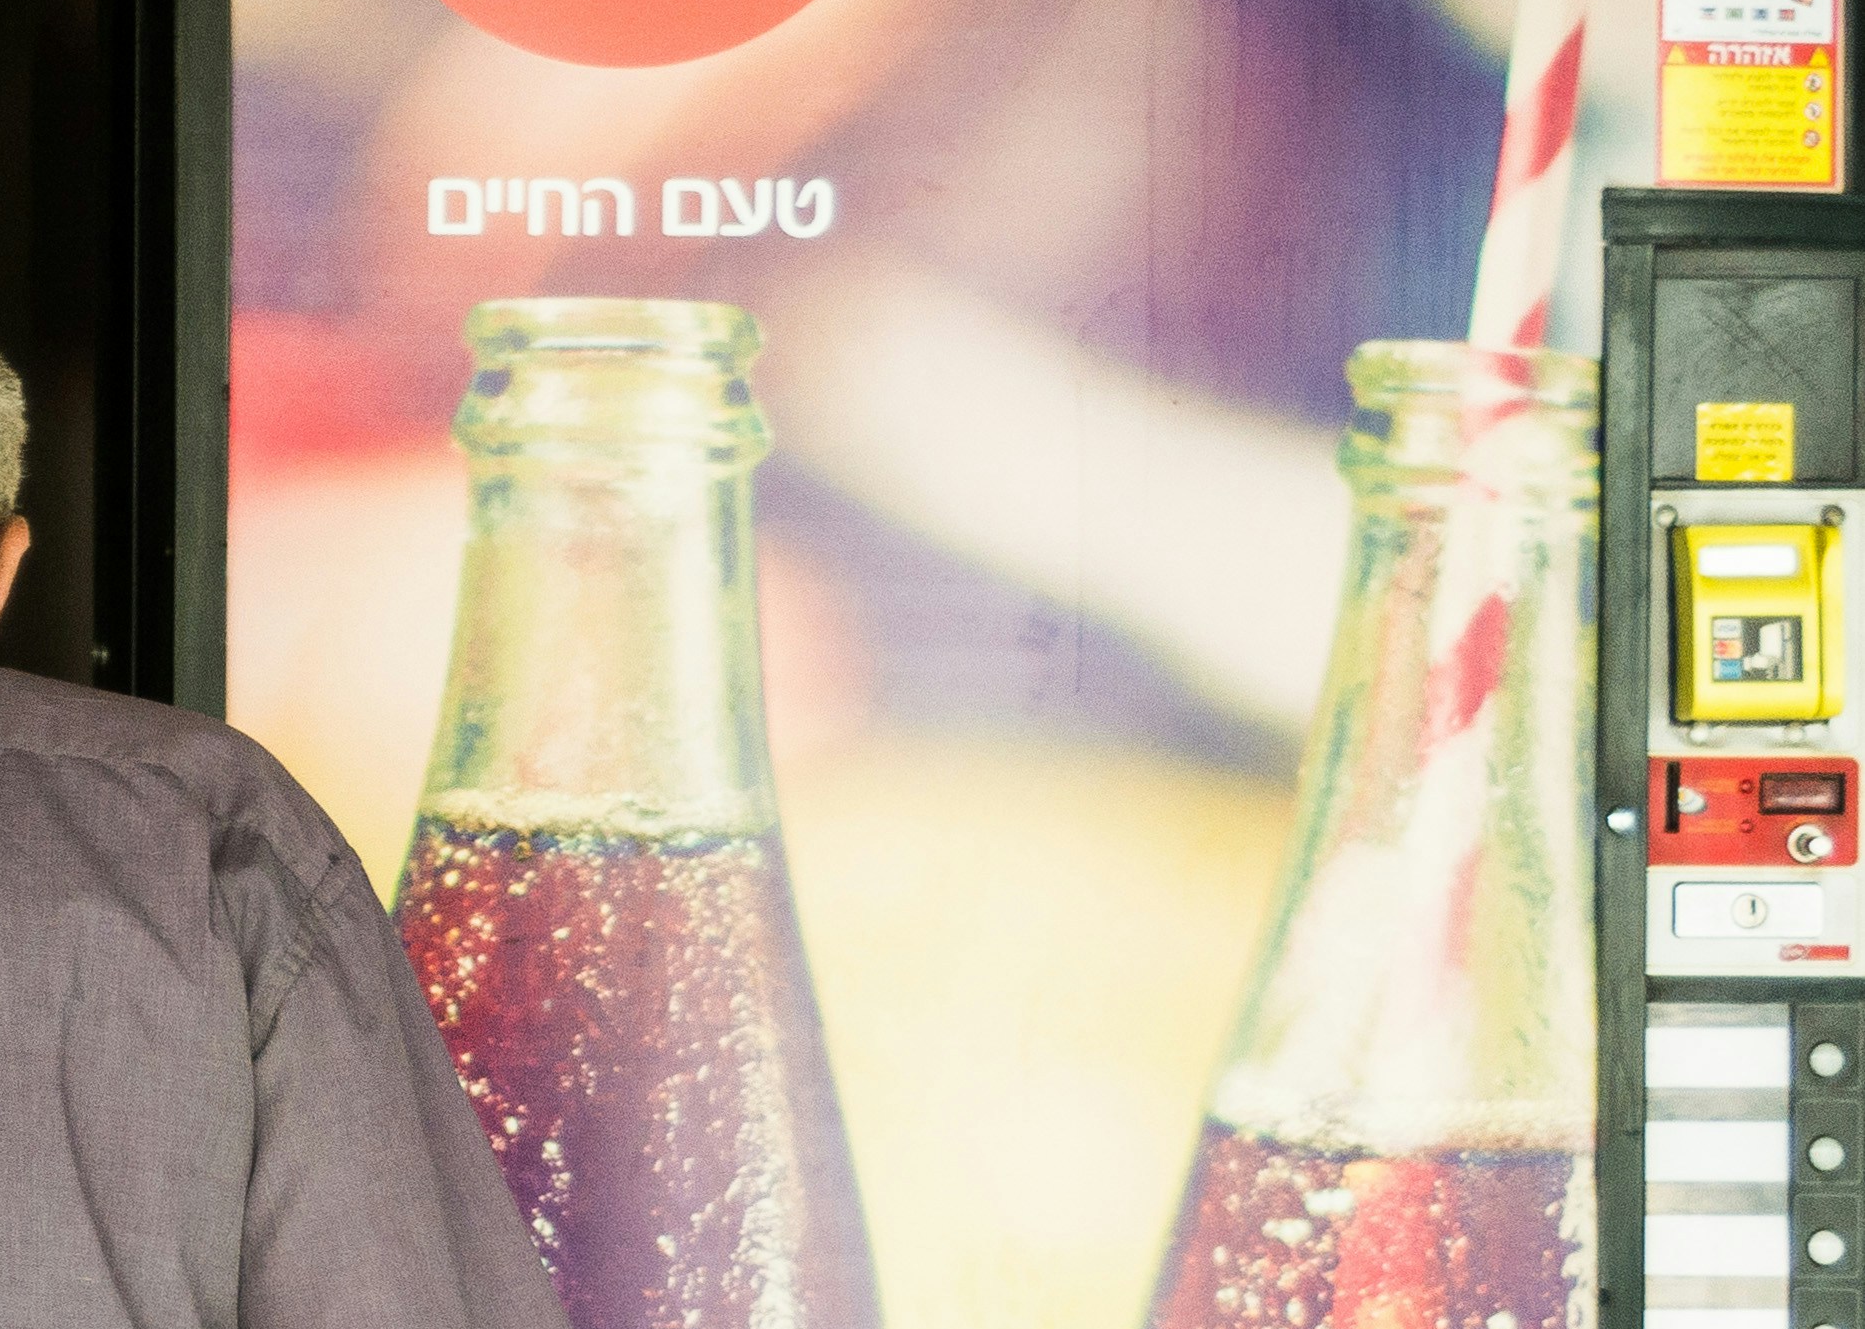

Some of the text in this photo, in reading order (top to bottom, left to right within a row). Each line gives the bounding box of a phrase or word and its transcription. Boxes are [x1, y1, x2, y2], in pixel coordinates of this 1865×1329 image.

[1706, 43, 1791, 65] אזהרה
[427, 177, 836, 239] טעם החיים
